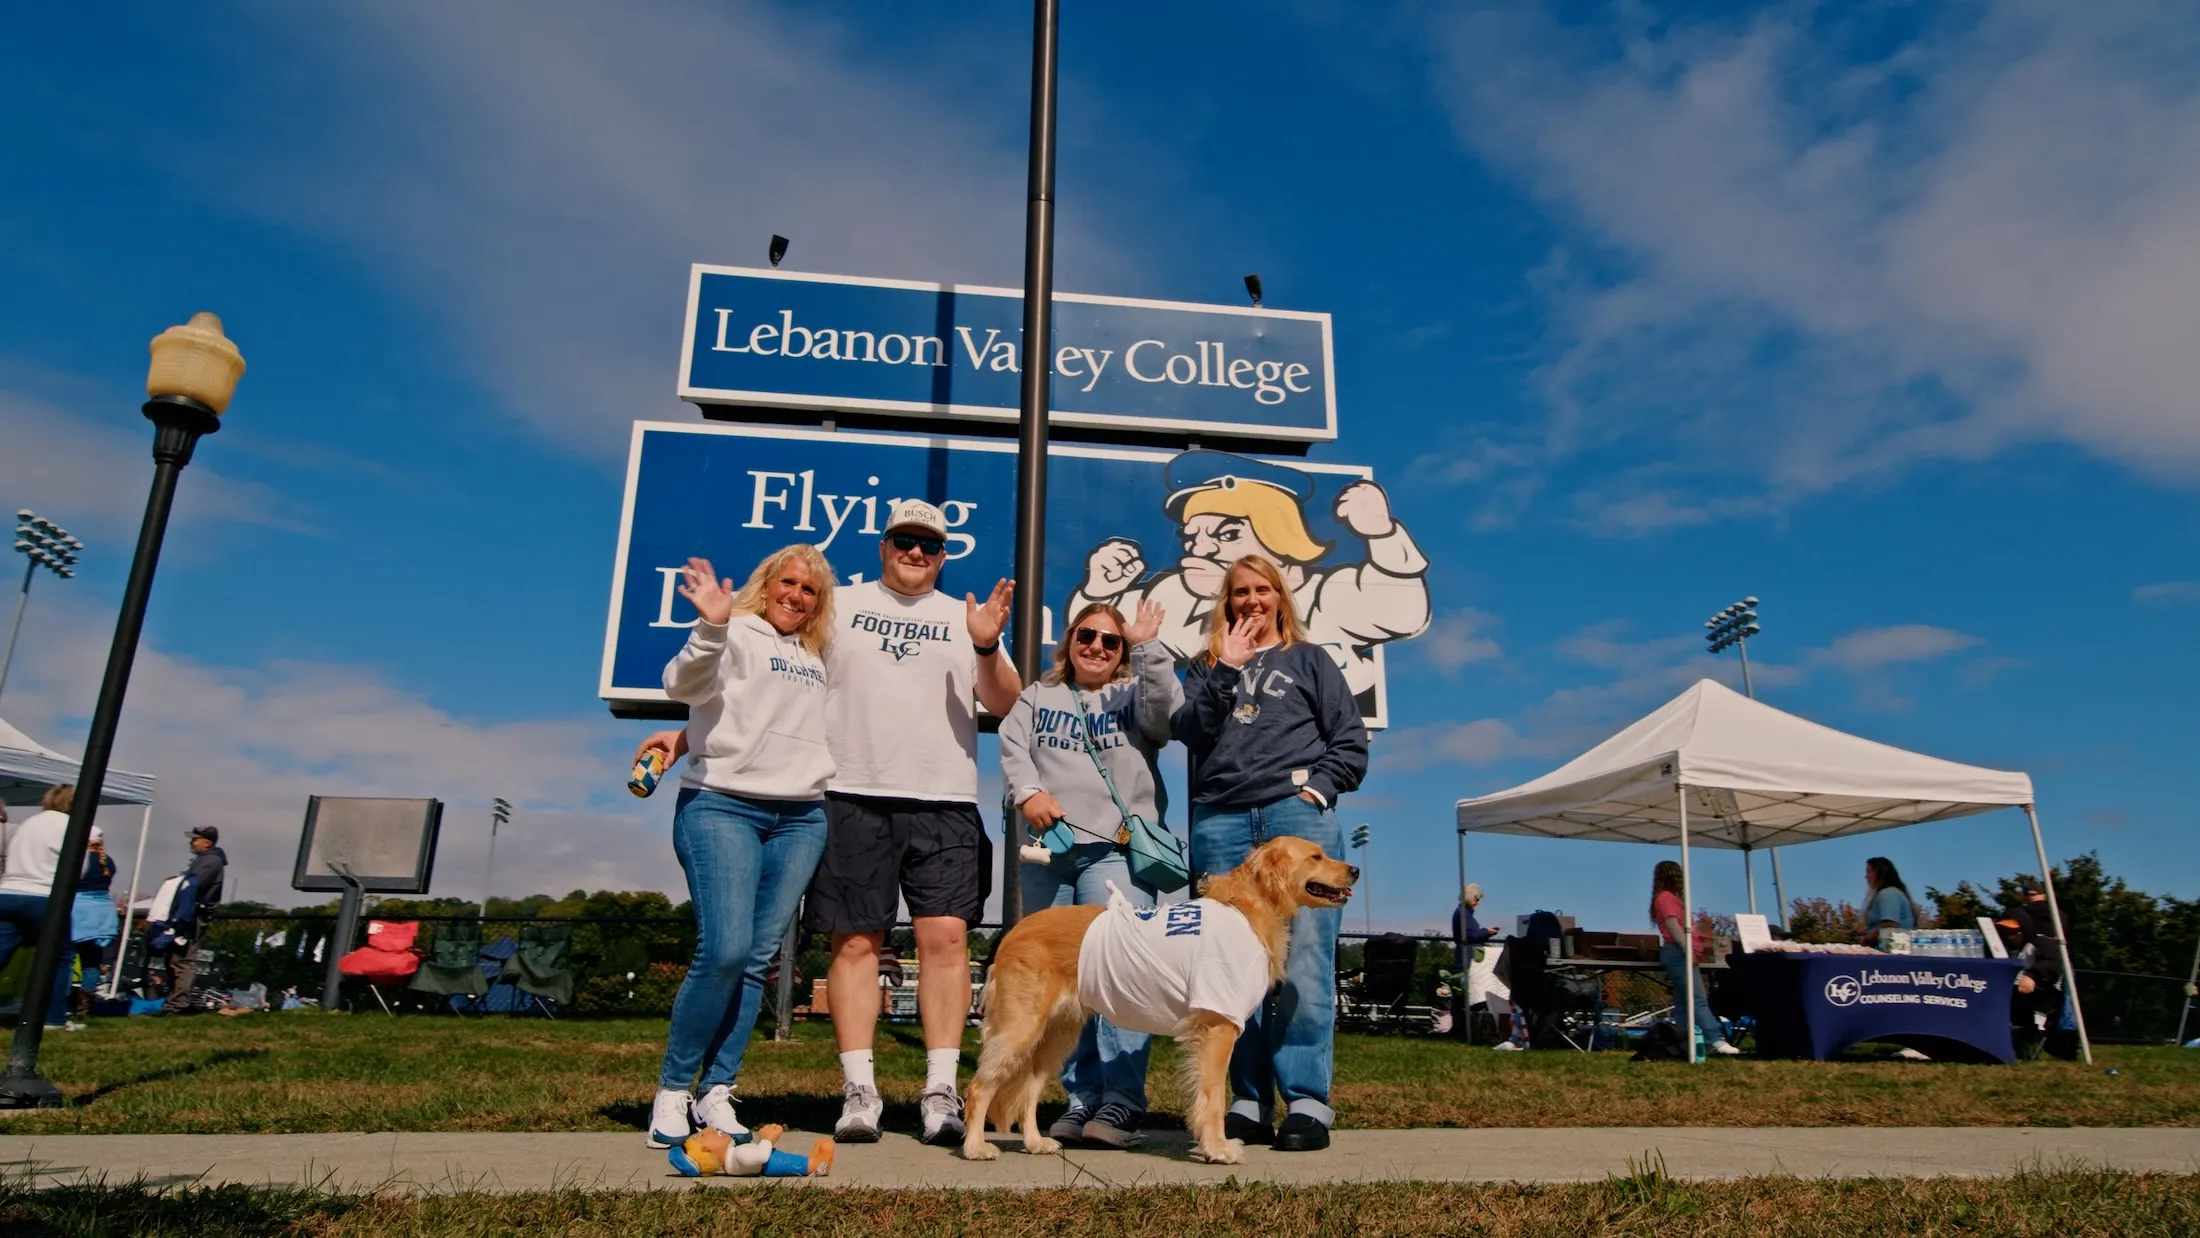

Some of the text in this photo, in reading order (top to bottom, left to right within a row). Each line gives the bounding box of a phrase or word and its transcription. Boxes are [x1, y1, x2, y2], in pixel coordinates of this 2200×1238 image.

[711, 308, 1311, 405] Lebanon Vaey College
[742, 469, 978, 560] Flyig
[904, 509, 936, 522] BUSCH
[851, 613, 952, 642] FOOTBALL
[878, 637, 921, 662] LVC
[1232, 667, 1294, 698] VC
[1035, 706, 1131, 739] DUTCMEN
[1860, 969, 1988, 993] Lebanon Valley College
[1859, 994, 1968, 1008] COUNSELING SERVICES
